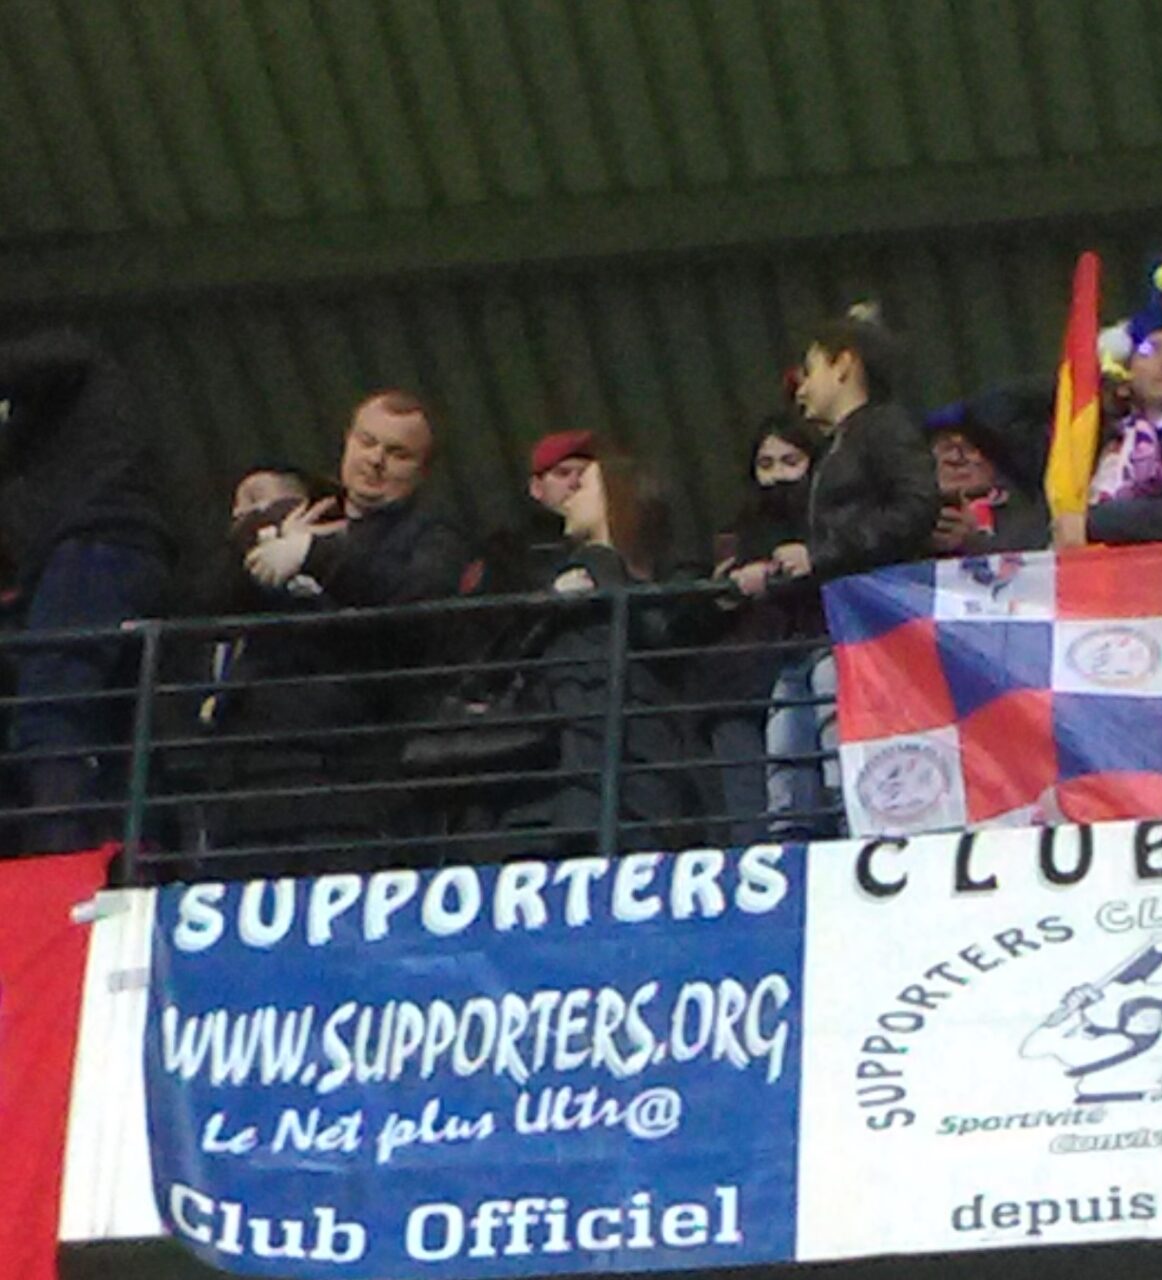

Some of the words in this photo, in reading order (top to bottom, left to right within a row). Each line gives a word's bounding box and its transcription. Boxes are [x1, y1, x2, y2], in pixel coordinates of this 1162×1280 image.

[174, 843, 788, 950] SUPPORTERS
[162, 972, 791, 1095] WWW.SUPPORTERS.ORG
[856, 915, 1075, 1130] SUPPORTERS
[202, 1110, 259, 1153] Le
[271, 1107, 363, 1153] Net
[377, 1097, 495, 1165] plus
[515, 1086, 682, 1139] Ultr@
[170, 1183, 367, 1264] Club
[405, 1185, 744, 1261] Officiel
[951, 1185, 1157, 1237] depuis
